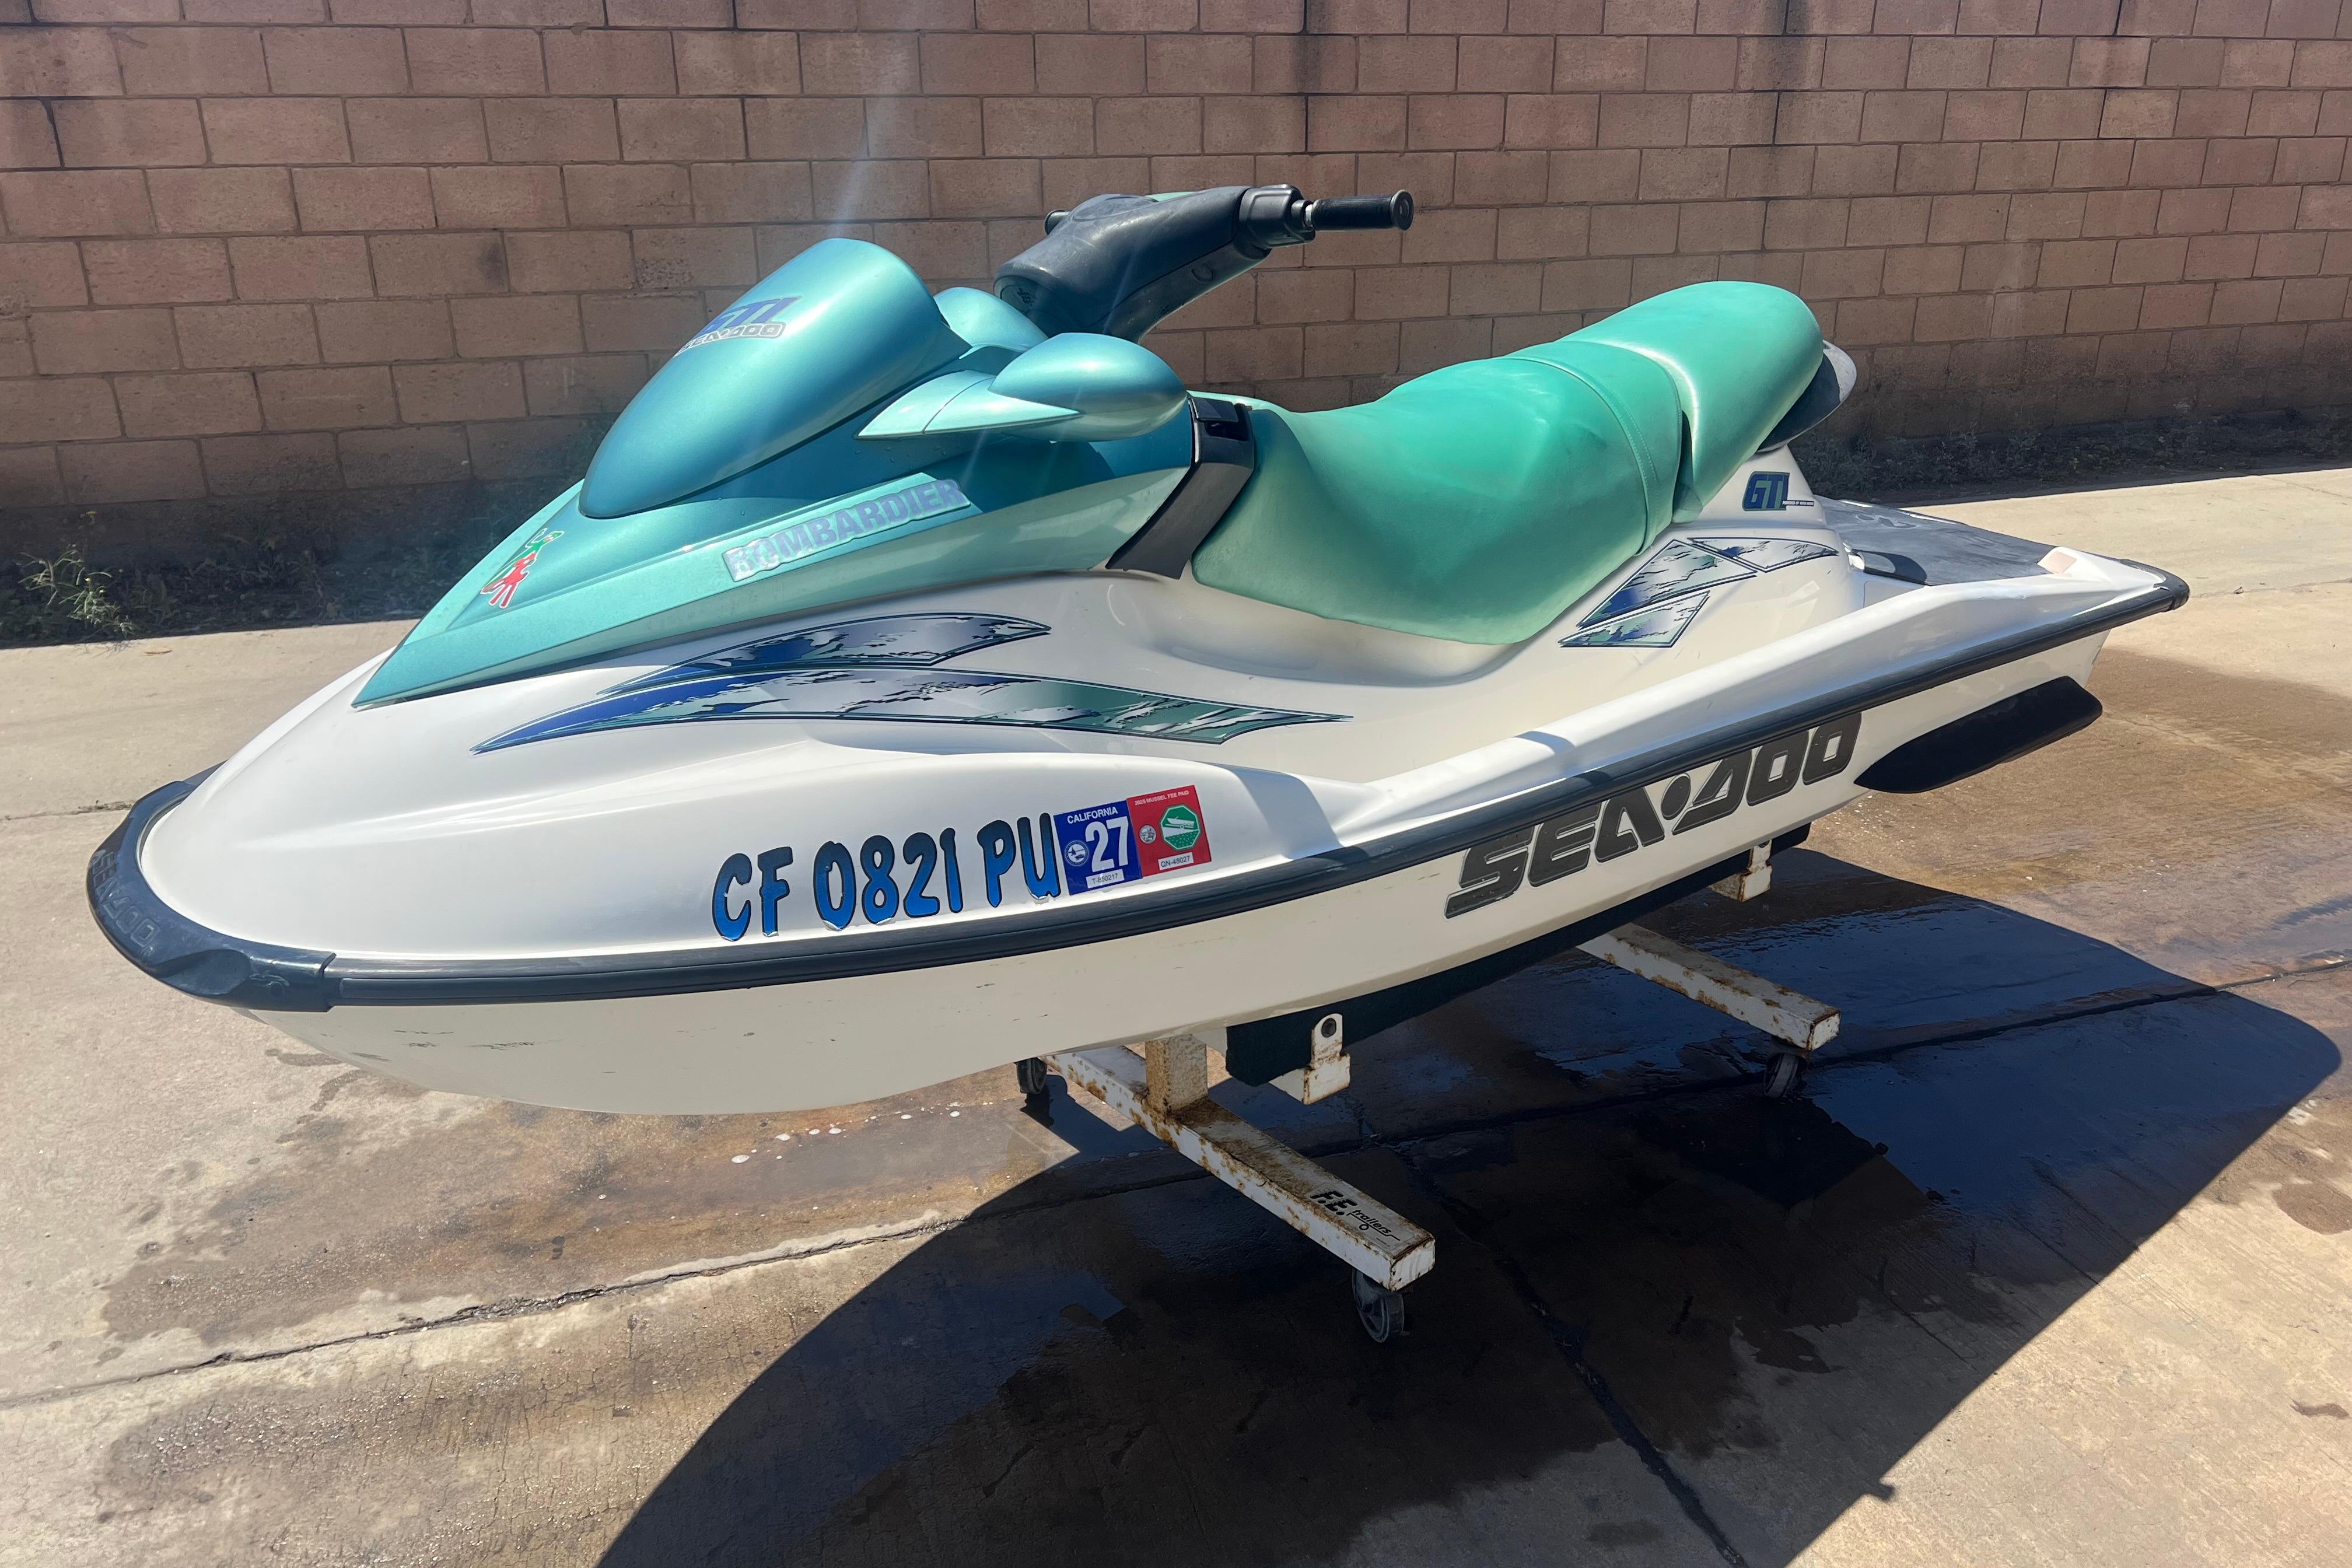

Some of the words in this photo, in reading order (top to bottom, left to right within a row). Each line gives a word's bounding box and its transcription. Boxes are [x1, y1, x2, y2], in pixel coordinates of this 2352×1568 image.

[1744, 474, 1790, 509] GTI
[726, 480, 966, 575] BOMBARDIER
[1146, 794, 1167, 803] MUSSEL
[1068, 806, 1118, 824] CALIFORNIA
[1085, 816, 1129, 872] 27
[1160, 855, 1191, 867] QN-48027
[712, 846, 794, 942] CF
[813, 827, 963, 931] 0821
[977, 813, 1062, 908] PU
[1092, 873, 1118, 884] T-850217
[1352, 1209, 1392, 1234] trailers
